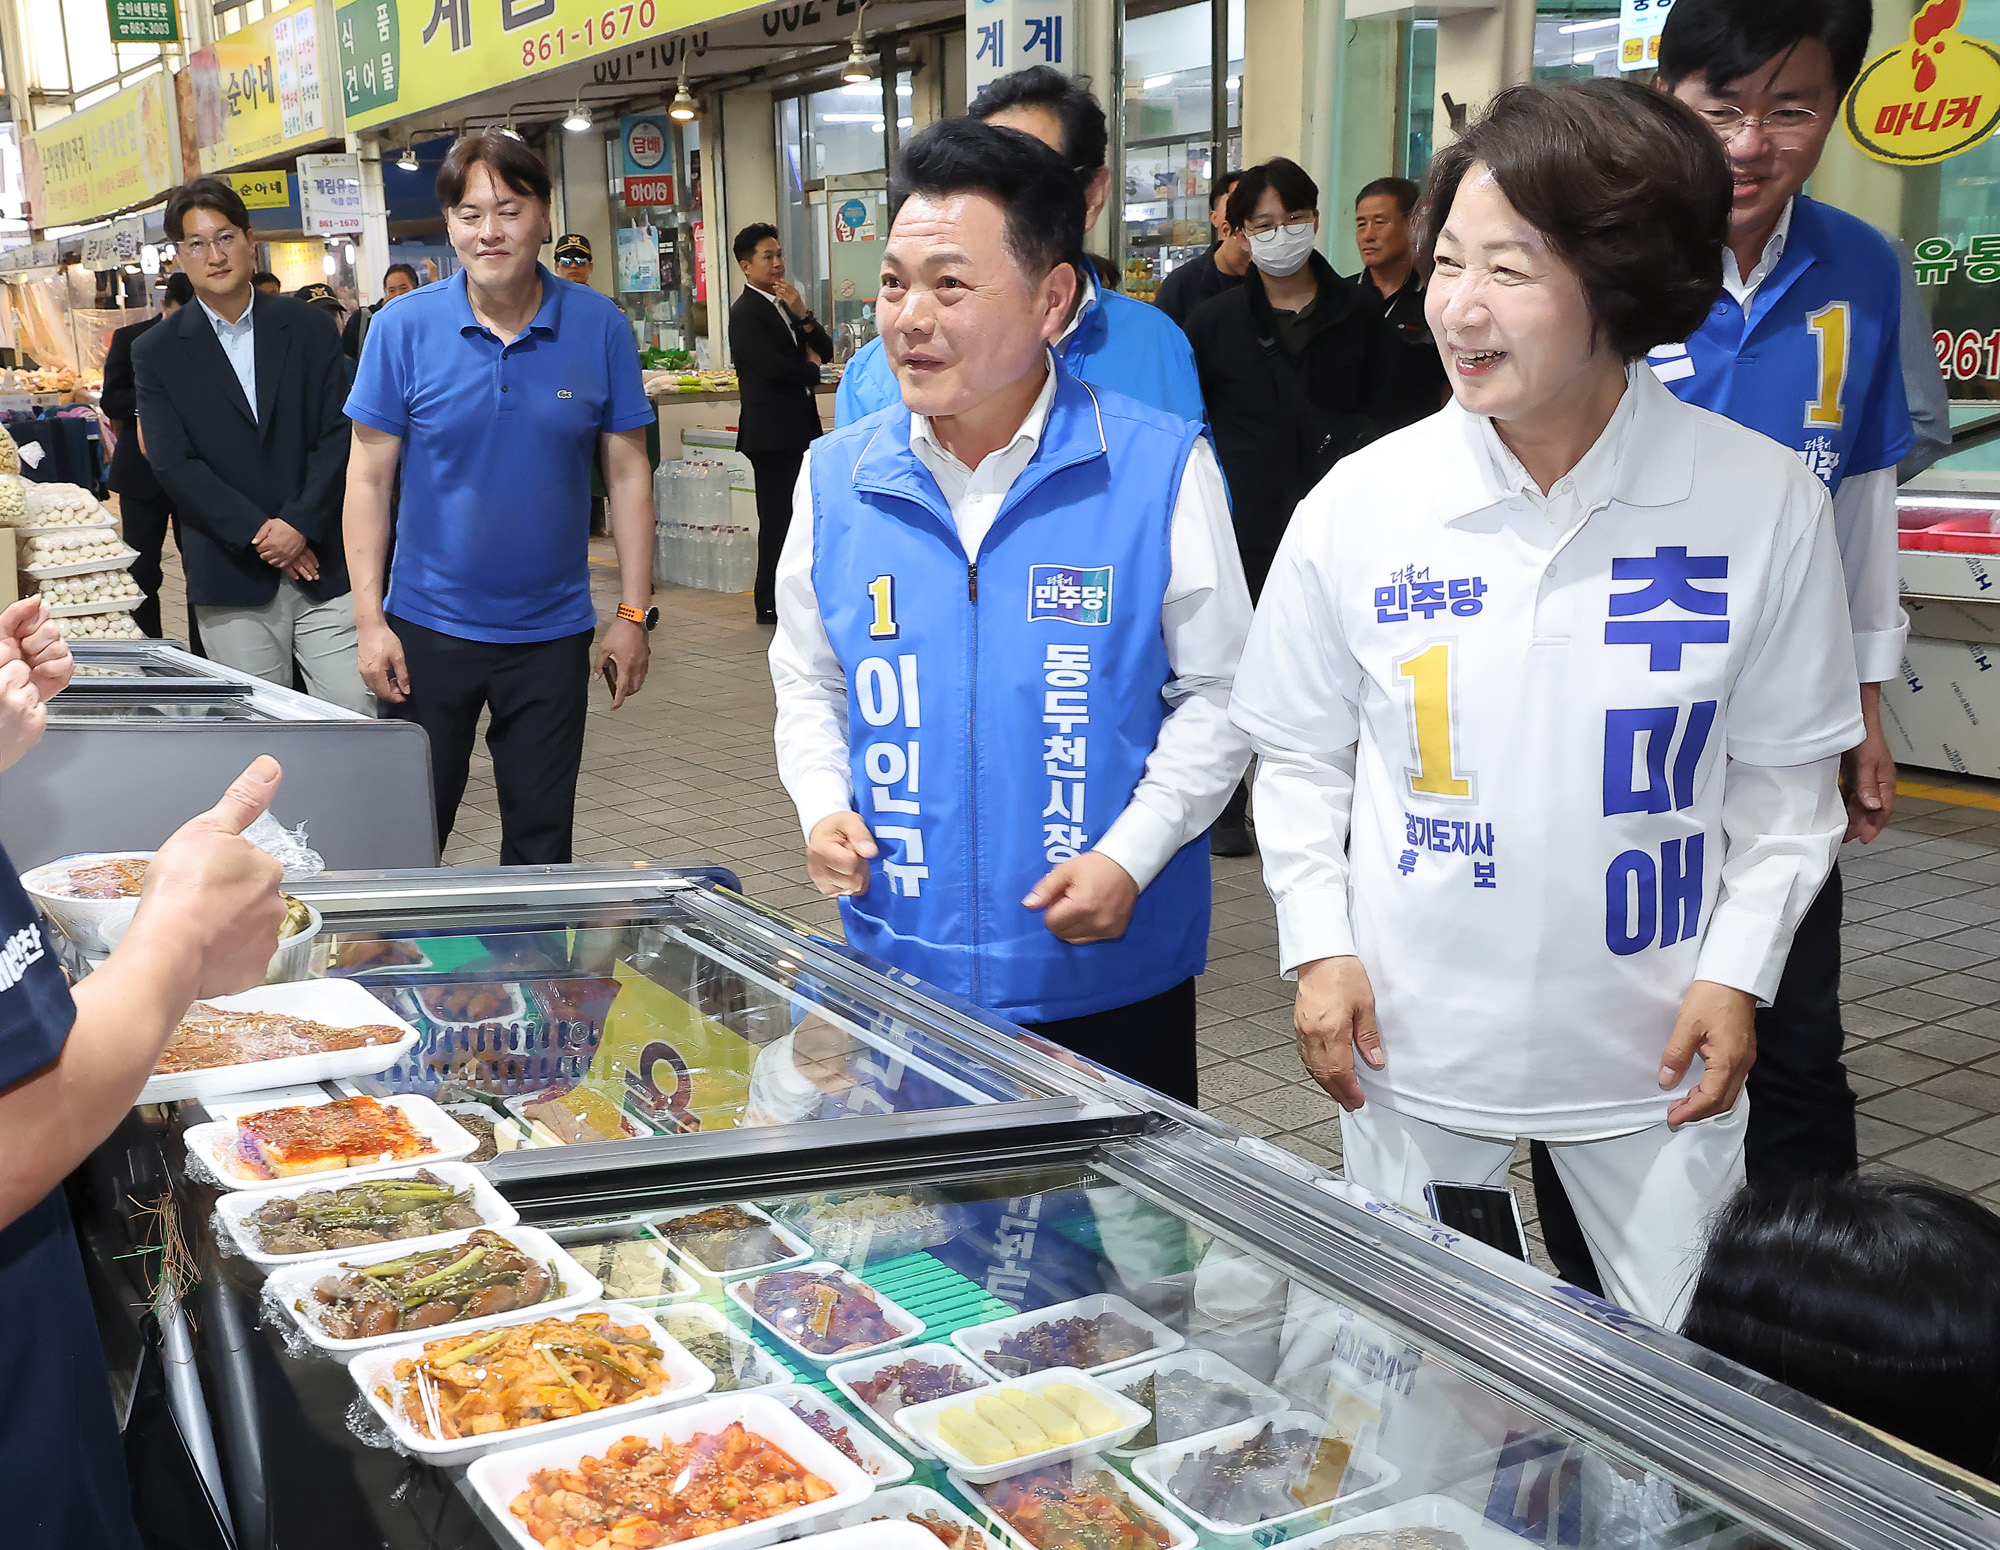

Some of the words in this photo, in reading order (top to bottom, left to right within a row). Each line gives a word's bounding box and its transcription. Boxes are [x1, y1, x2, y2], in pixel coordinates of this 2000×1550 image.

[521, 0, 656, 67] 861-1670
[226, 56, 275, 117] 순아네
[344, 52, 395, 105] 건어물
[1875, 95, 1982, 136] 마니커
[239, 181, 283, 196] 순아네
[319, 218, 359, 228] 861-1670
[1912, 233, 2000, 286] 유통
[1803, 300, 1852, 430] 1
[1034, 585, 1108, 611] 민주당
[1045, 572, 1074, 587] 더불어
[1374, 576, 1488, 624] 민주당
[1390, 562, 1430, 586] 더불어
[867, 574, 900, 640] 1
[1392, 635, 1480, 806] 1
[854, 654, 930, 898] 이인규
[1041, 643, 1093, 863] 동두천시장
[1602, 545, 1731, 957] 추미애
[1404, 811, 1495, 857] 경기도지사
